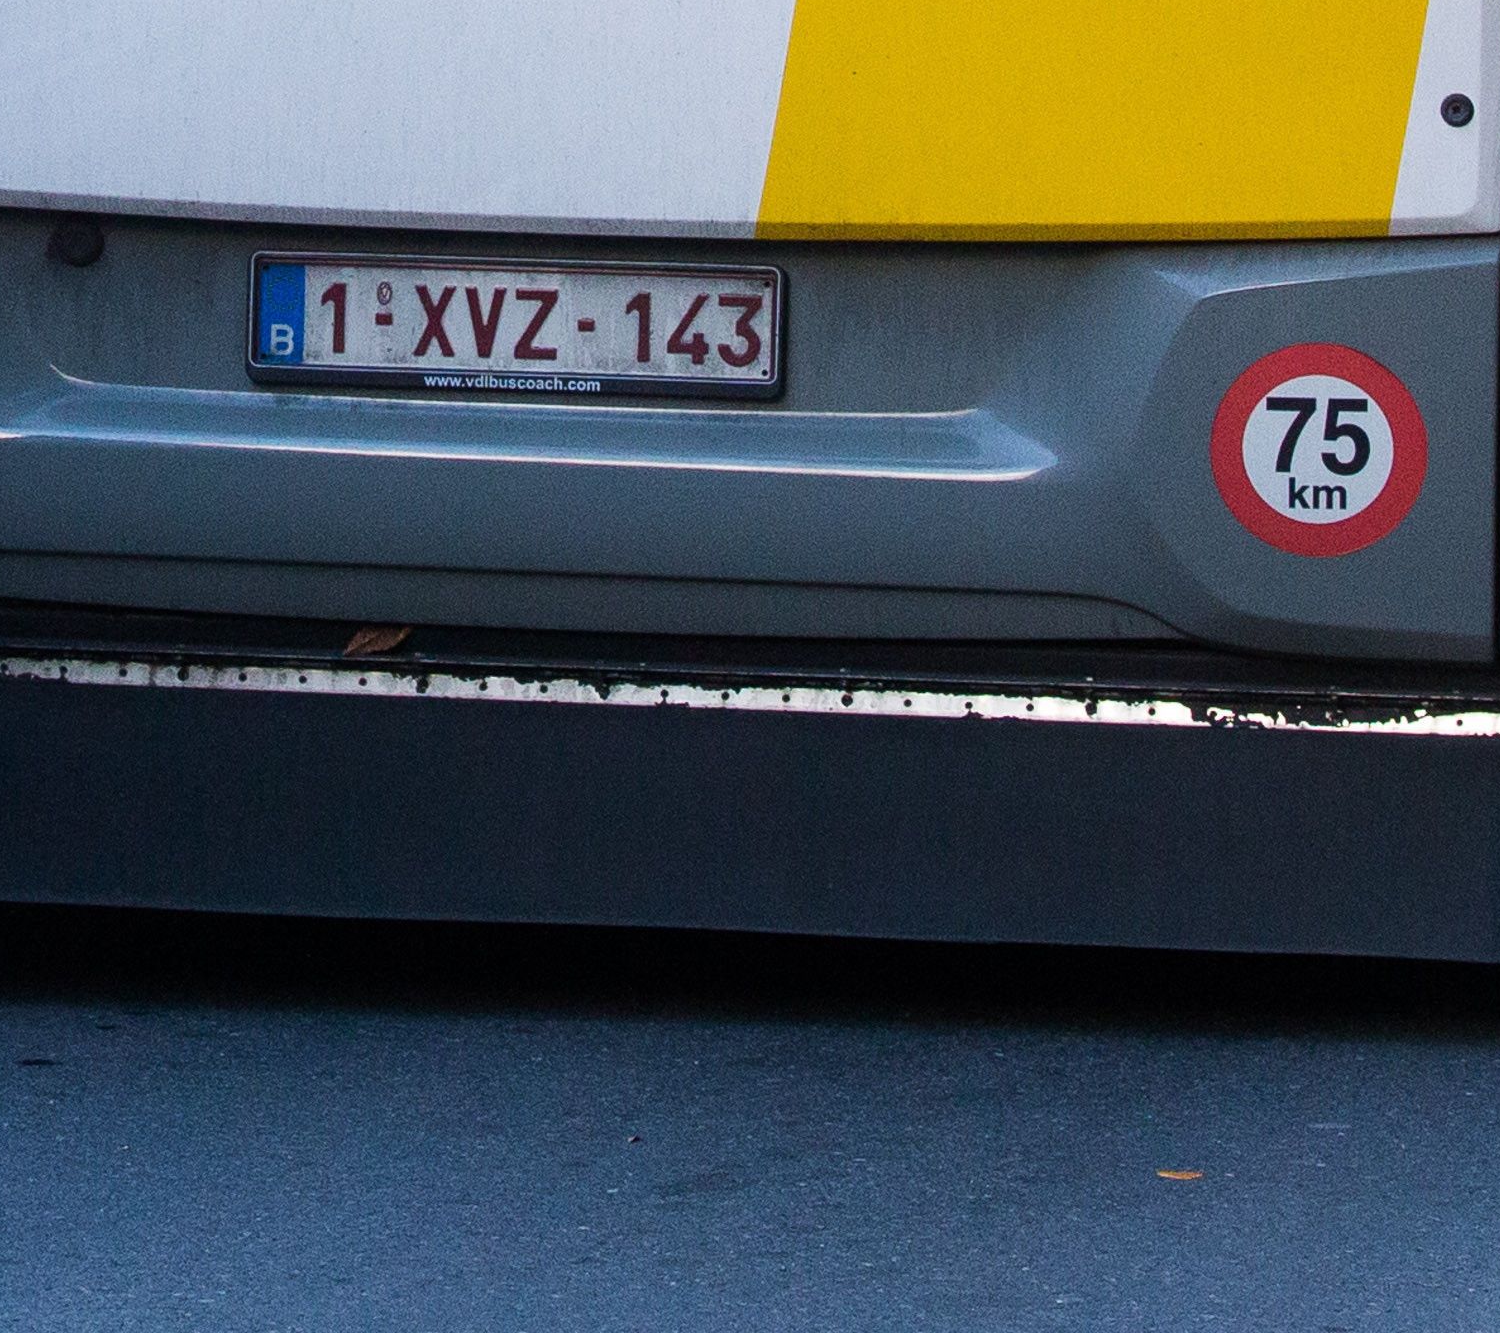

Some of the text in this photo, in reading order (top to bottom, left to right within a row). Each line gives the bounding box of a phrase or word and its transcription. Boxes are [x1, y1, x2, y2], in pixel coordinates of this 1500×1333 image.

[269, 322, 295, 358] B
[422, 372, 601, 394] www.vdlbuscoach.com
[1265, 396, 1371, 477] 75
[1287, 476, 1348, 511] km
